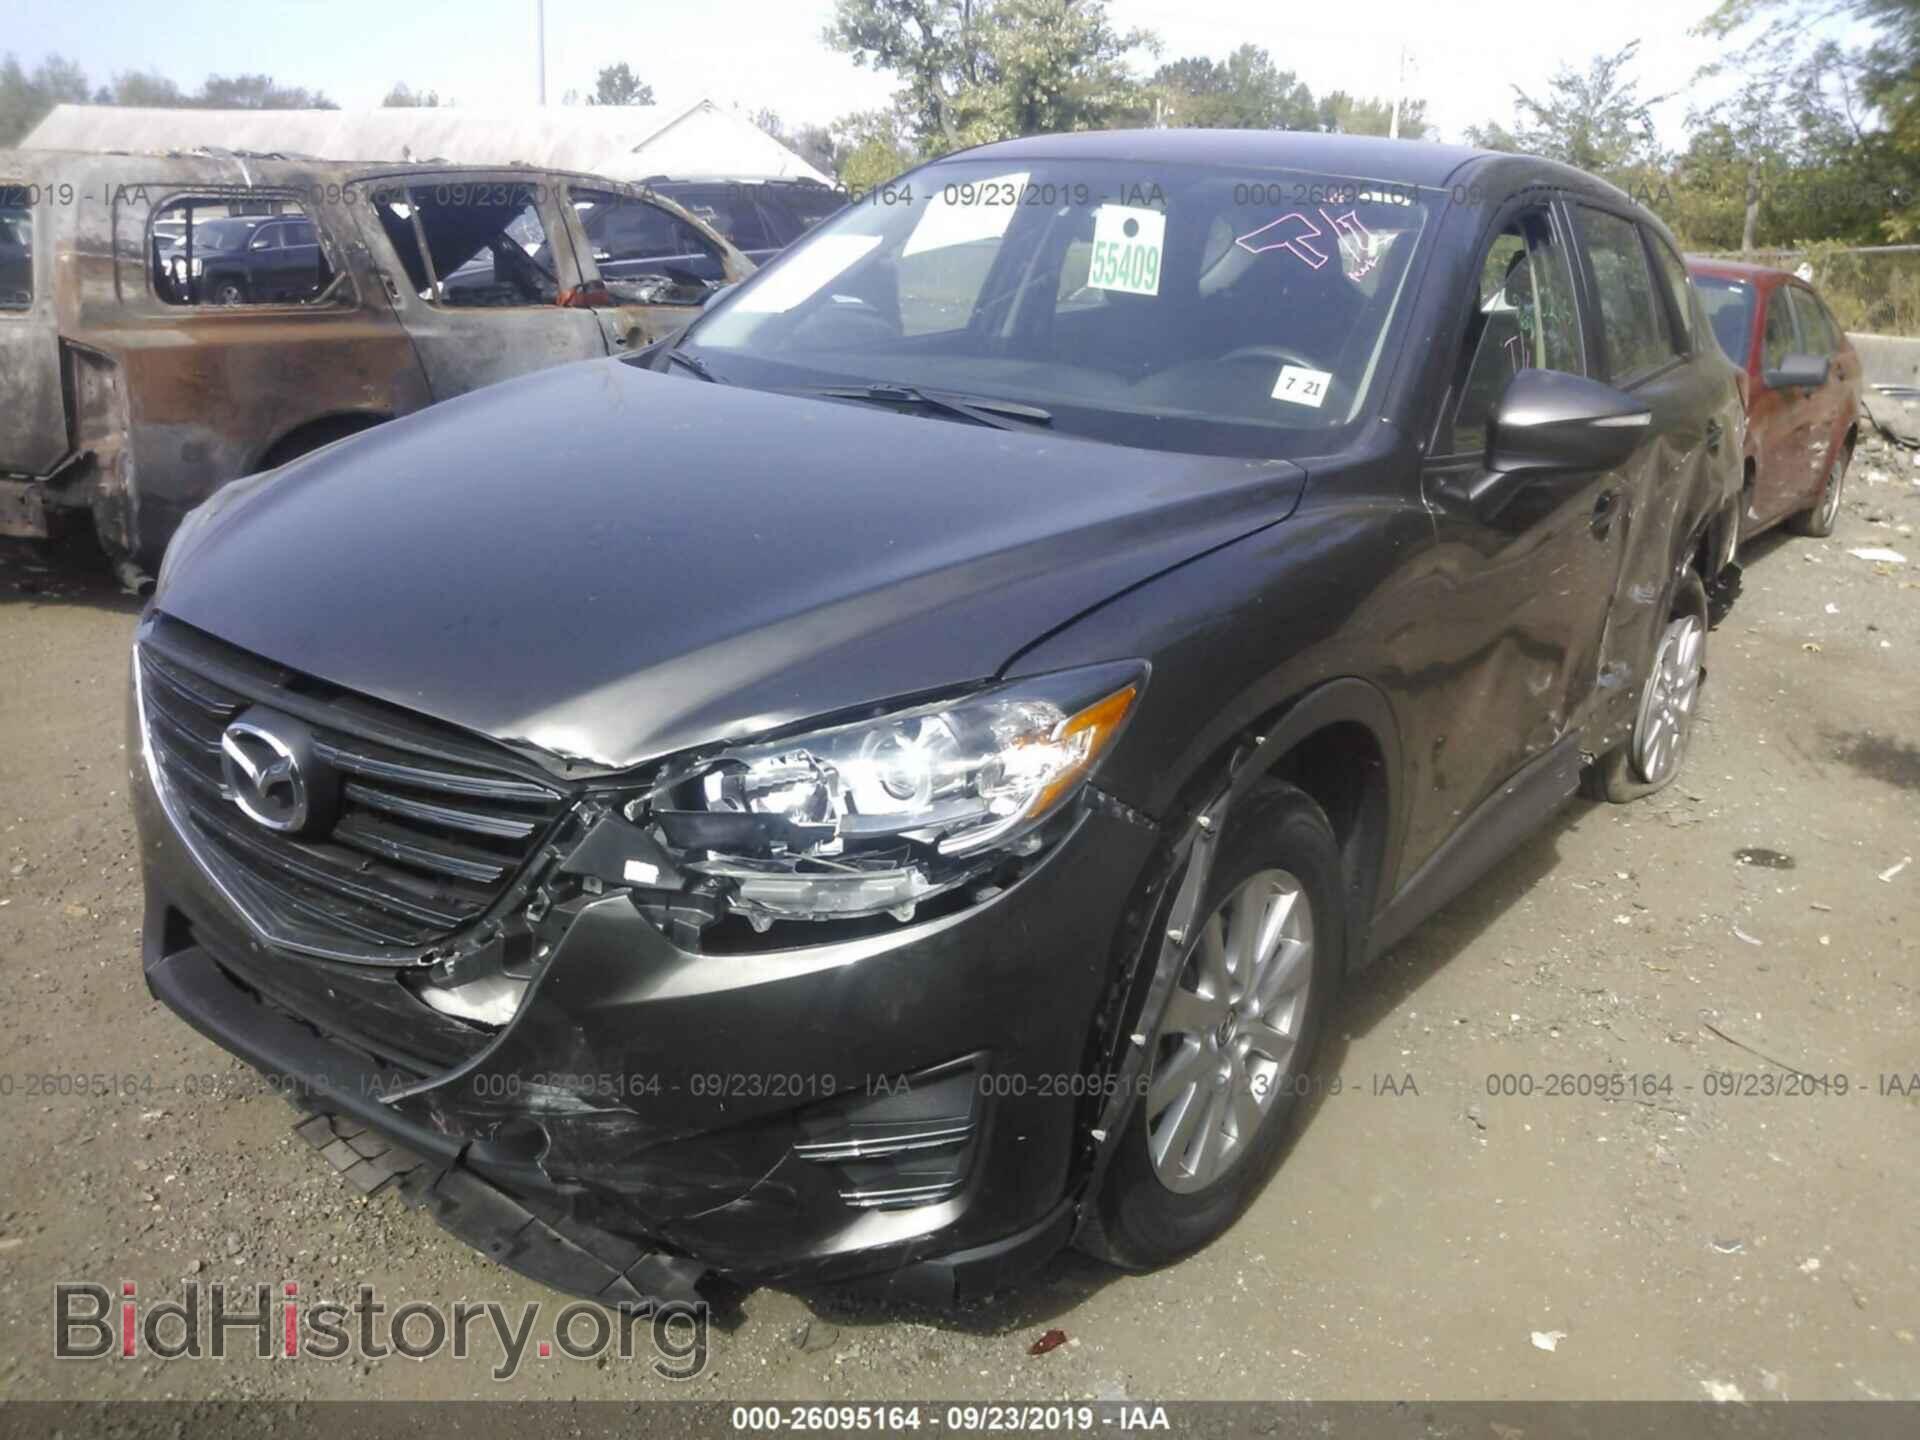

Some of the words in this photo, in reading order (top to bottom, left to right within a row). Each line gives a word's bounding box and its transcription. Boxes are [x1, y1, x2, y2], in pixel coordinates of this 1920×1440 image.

[1093, 240, 1158, 290] 55409
[1285, 376, 1297, 391] 7
[1303, 381, 1321, 397] 21
